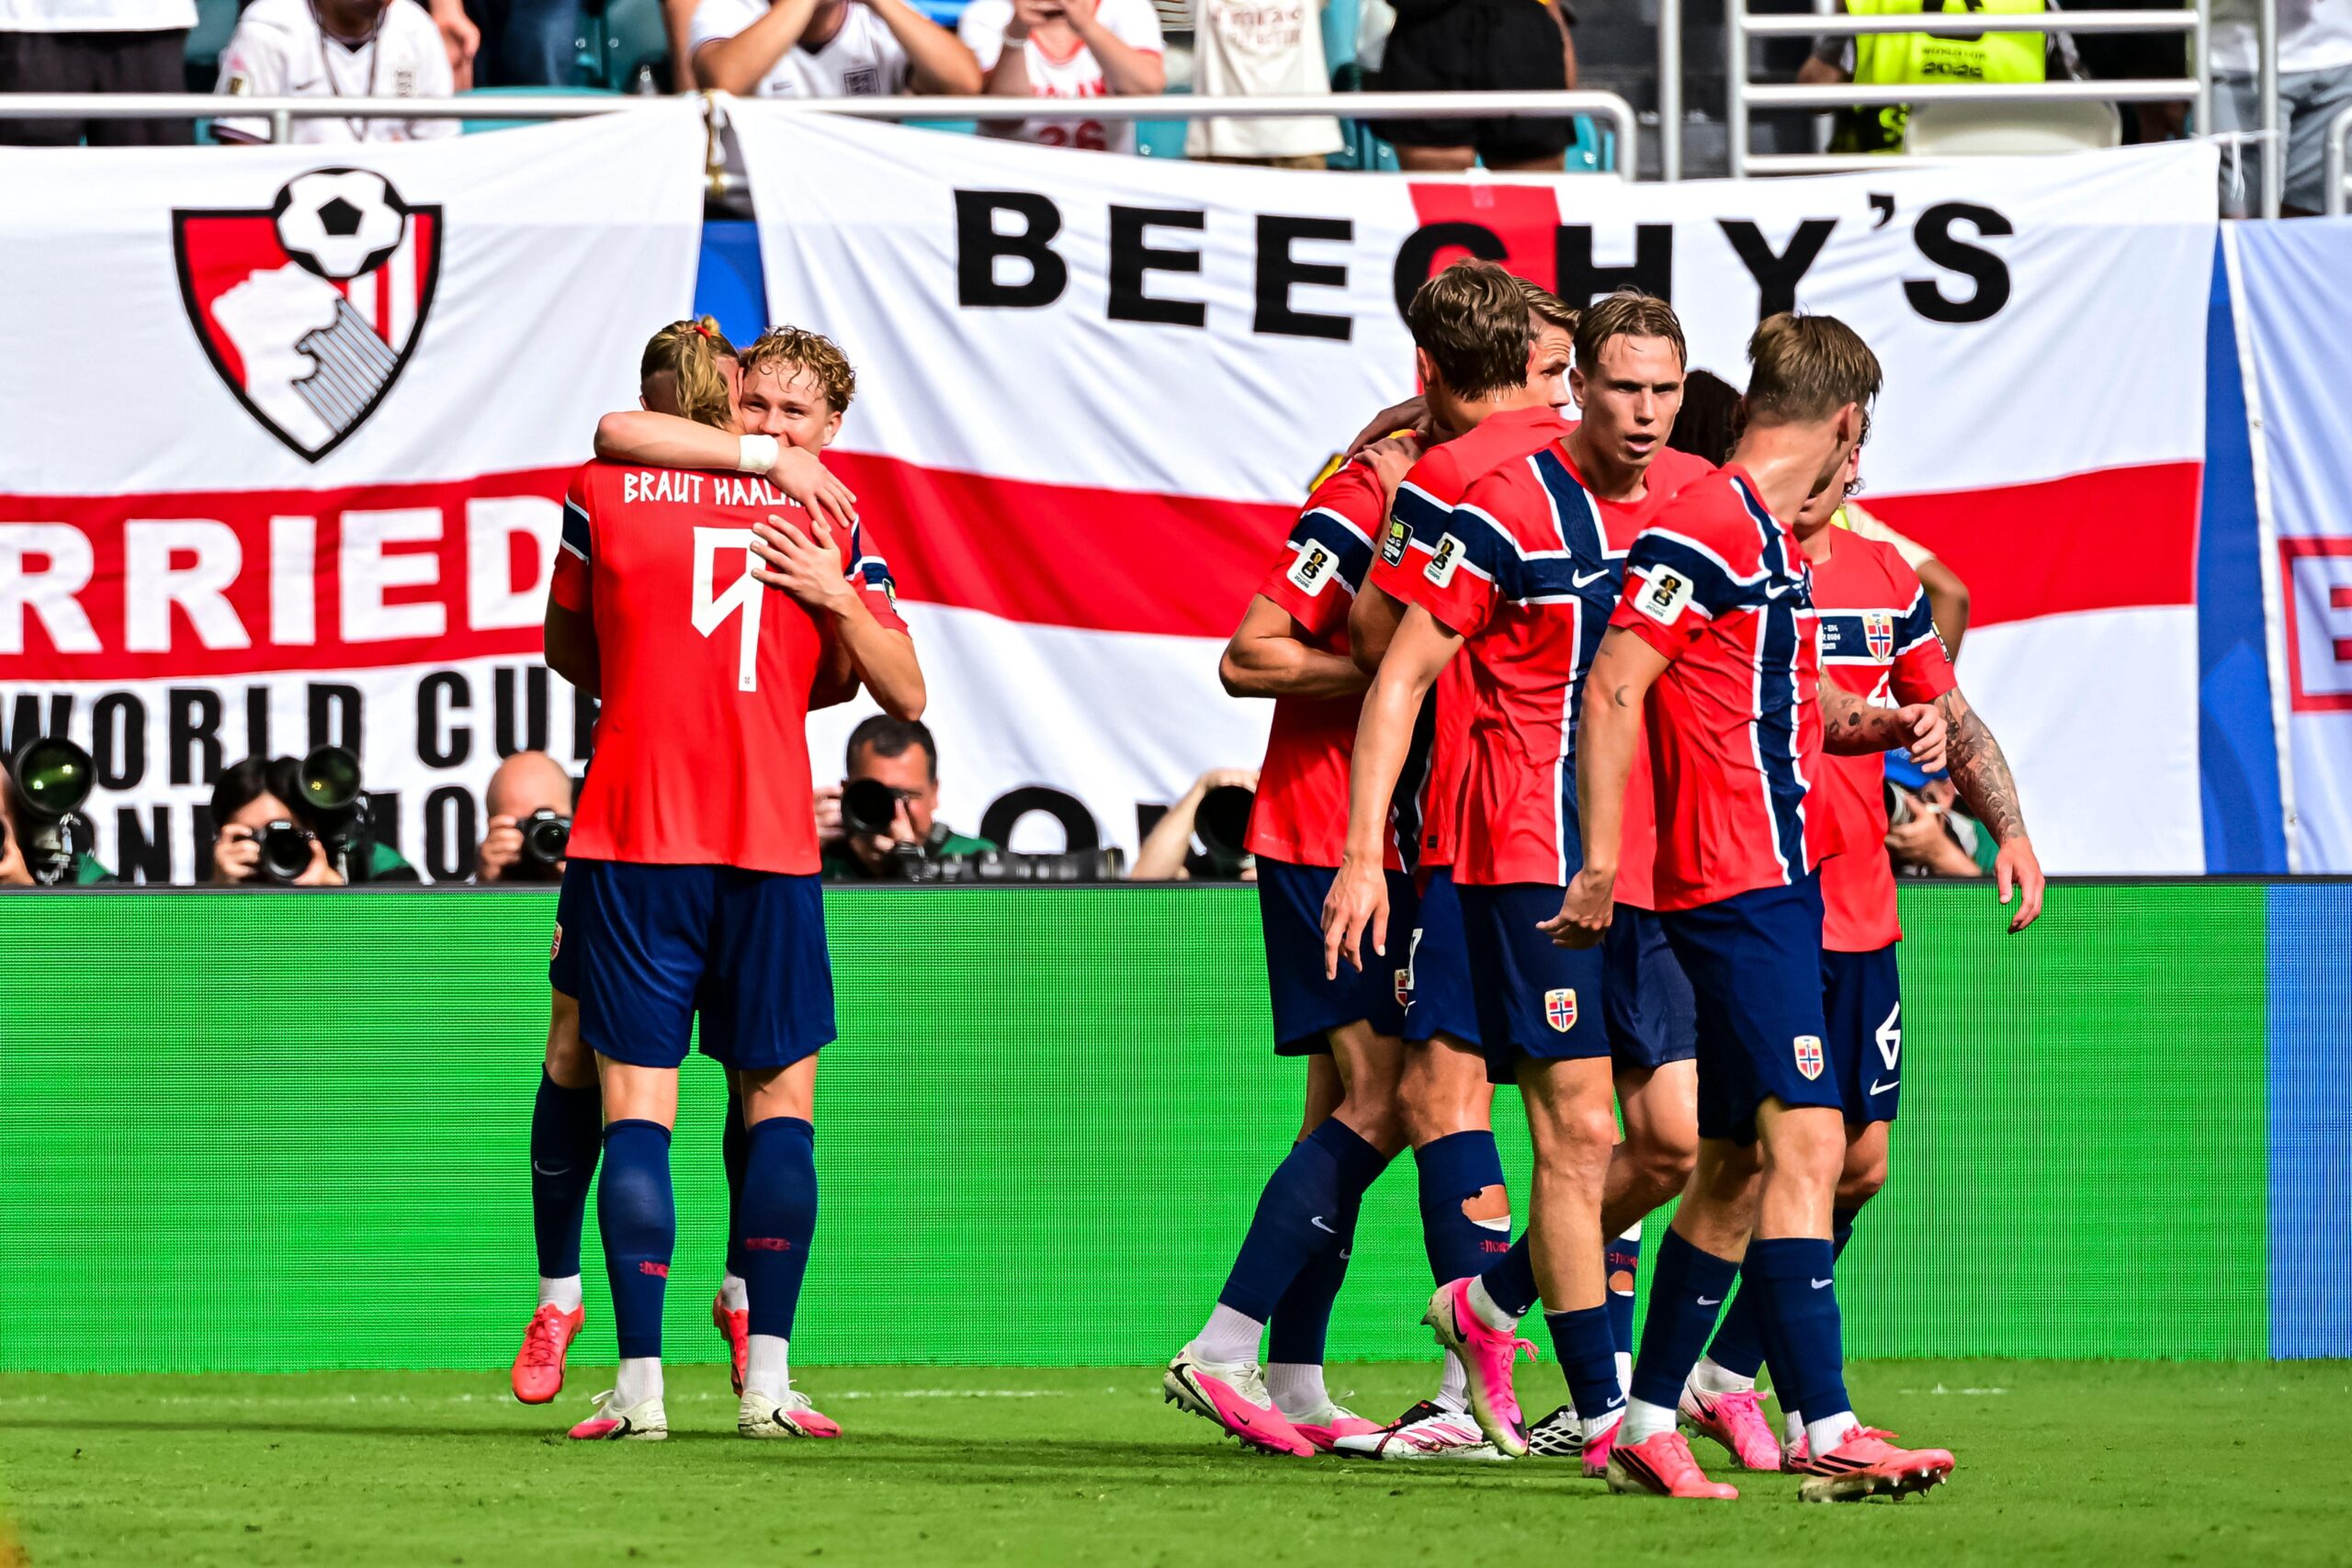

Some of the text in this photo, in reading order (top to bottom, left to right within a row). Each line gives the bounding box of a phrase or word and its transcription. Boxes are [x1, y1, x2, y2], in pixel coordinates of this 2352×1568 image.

[624, 471, 802, 507] BRAUT HAAL
[0, 496, 564, 654] RRIED
[691, 526, 768, 693] 9
[1875, 1000, 1901, 1070] 6
